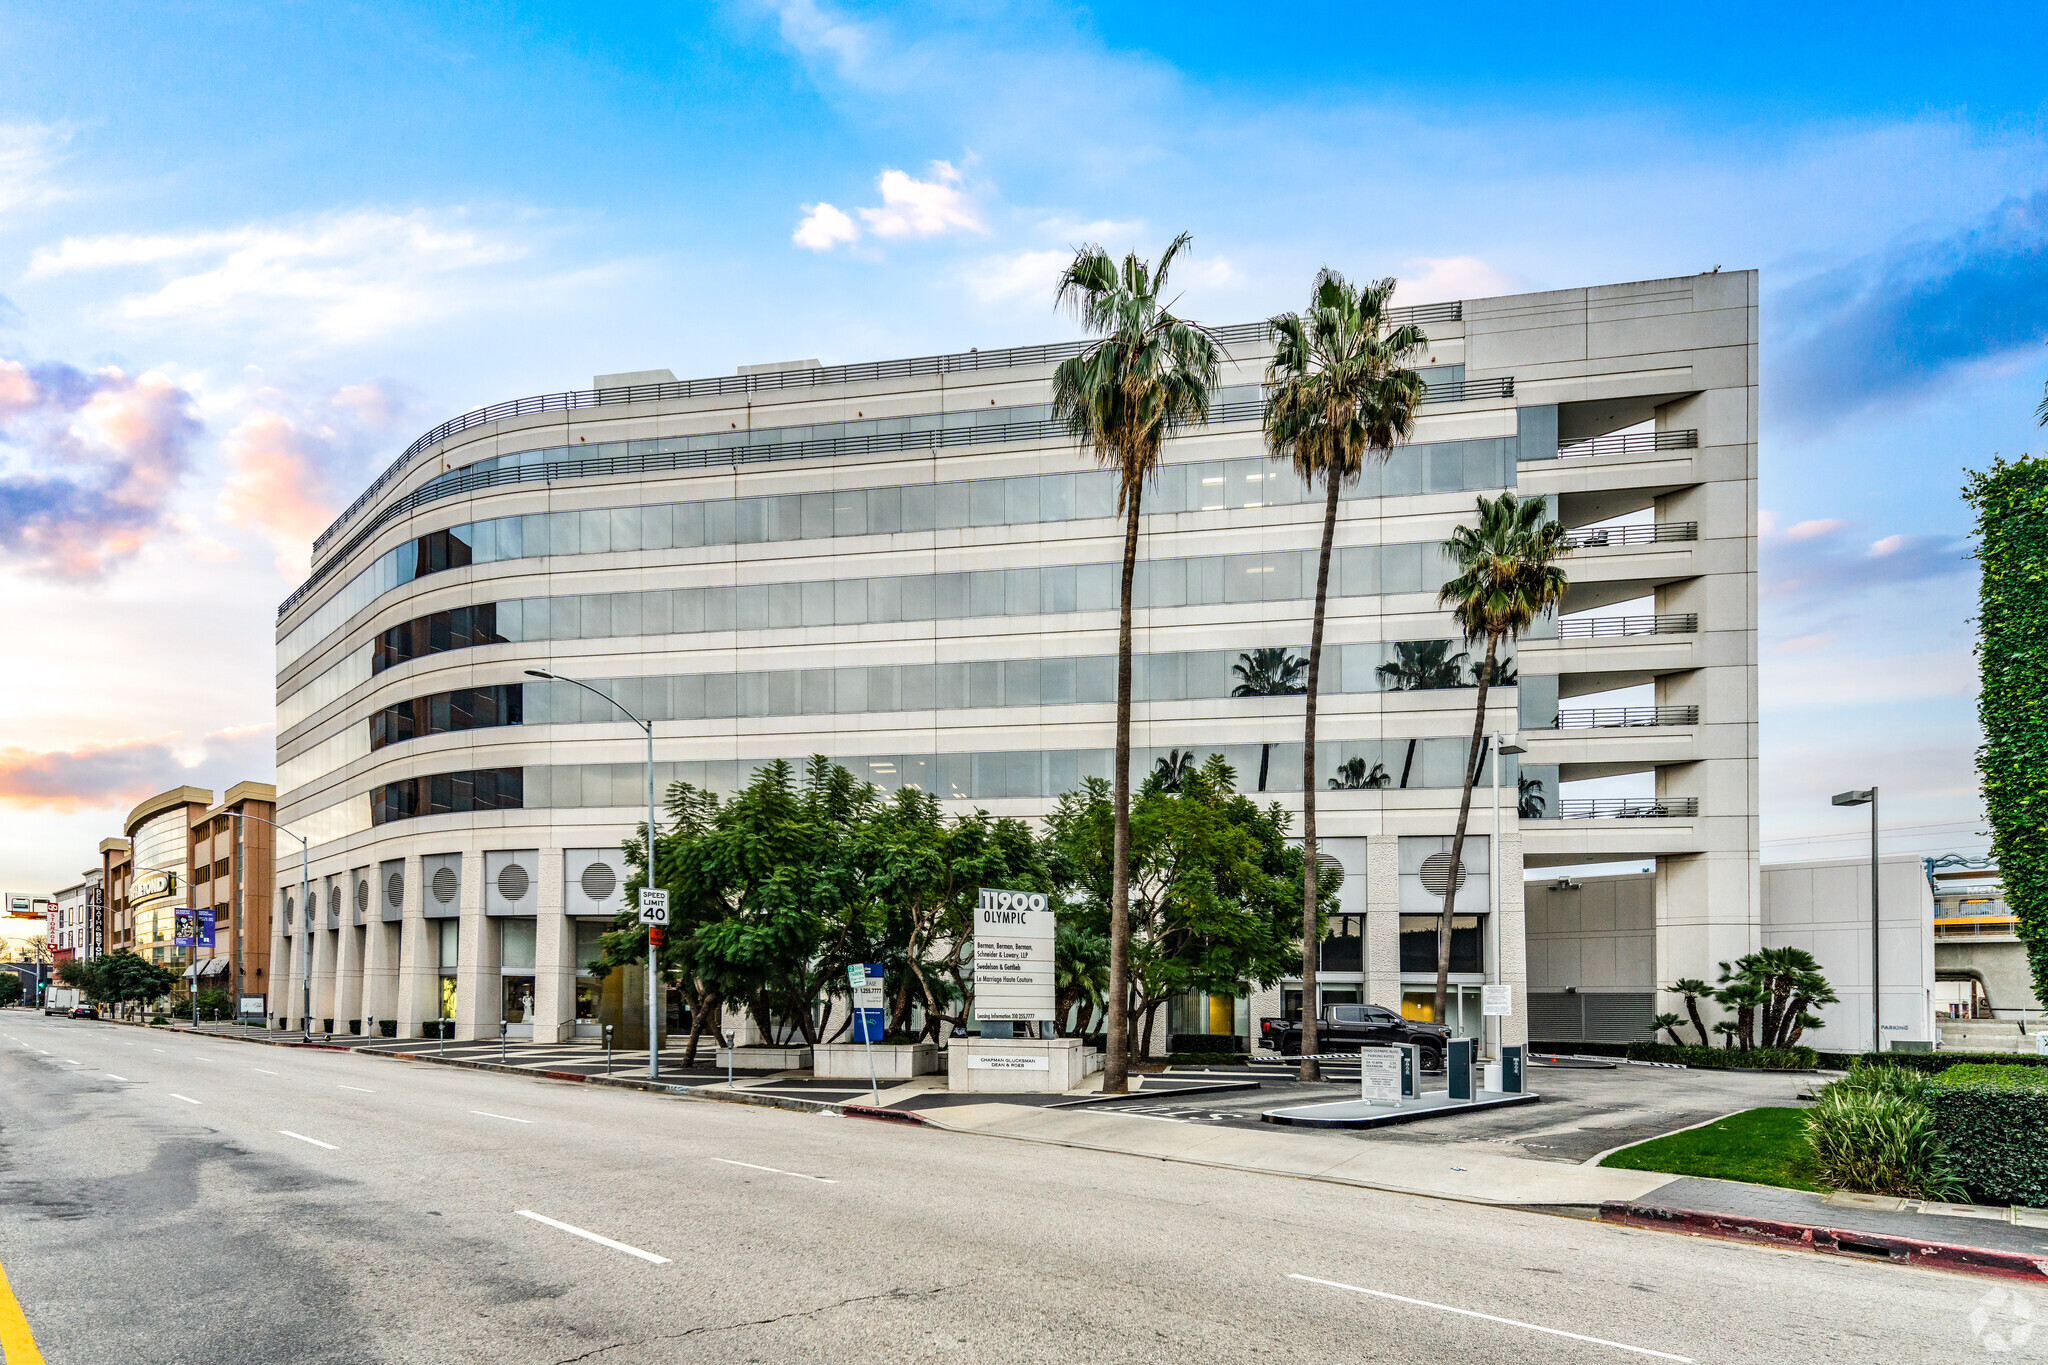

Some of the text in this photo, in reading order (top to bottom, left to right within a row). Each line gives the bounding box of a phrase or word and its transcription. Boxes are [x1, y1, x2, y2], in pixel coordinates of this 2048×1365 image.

[1966, 886, 2007, 895] Metr
[982, 891, 1046, 912] 11900
[644, 908, 665, 920] 40
[984, 910, 1027, 924] OLYMPIC
[977, 942, 1033, 952] Berman, Berman, Berman,
[1004, 963, 1021, 971] Gottlieb
[982, 975, 1002, 984] Marriage
